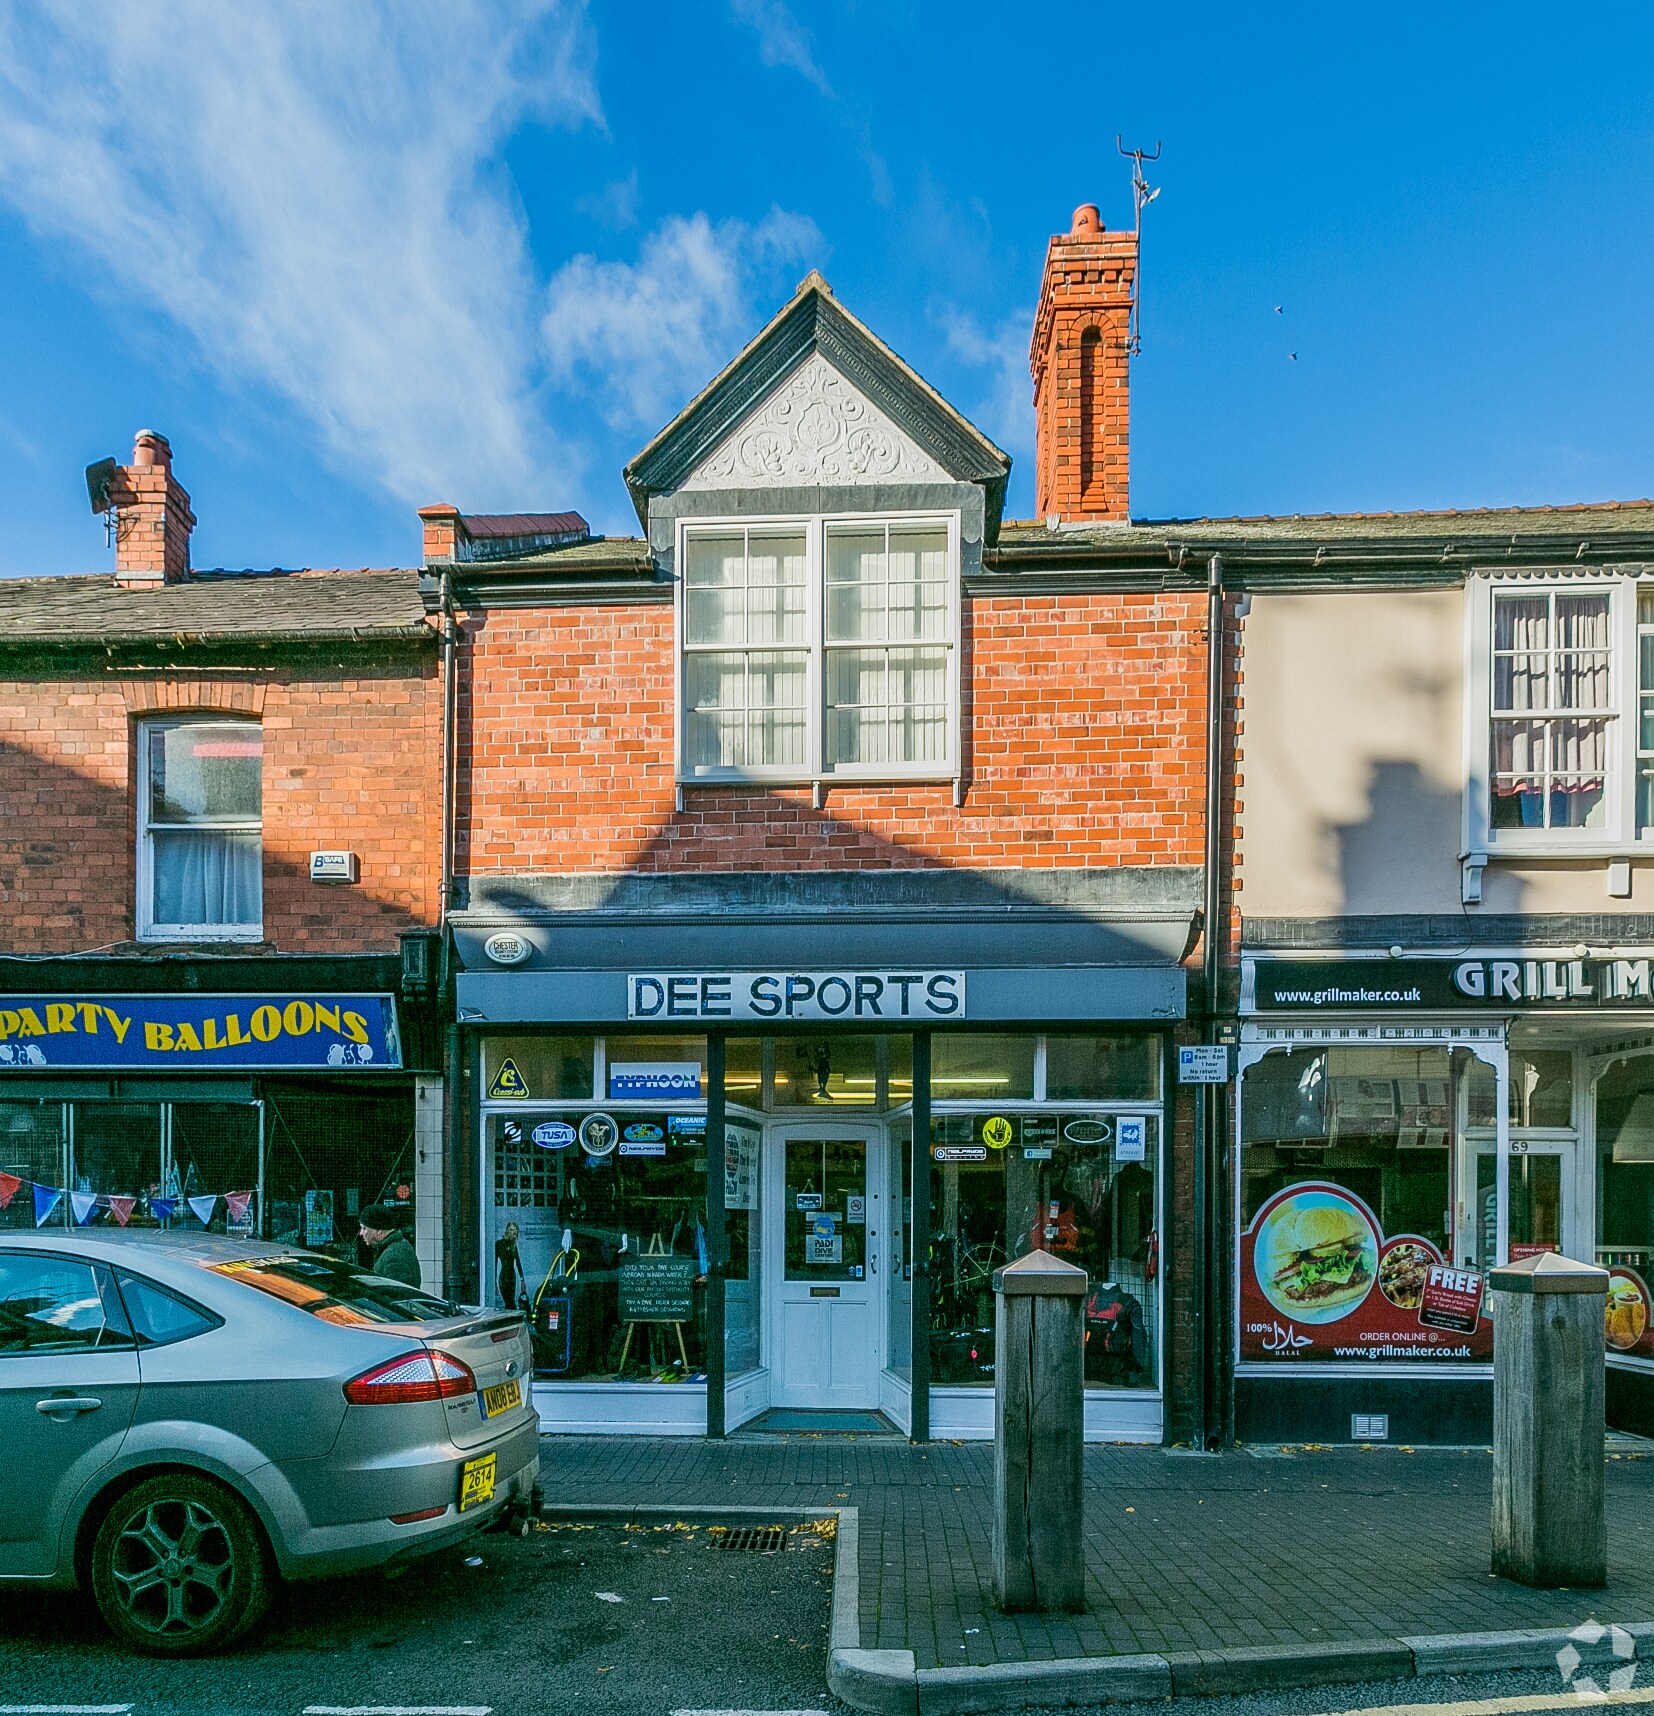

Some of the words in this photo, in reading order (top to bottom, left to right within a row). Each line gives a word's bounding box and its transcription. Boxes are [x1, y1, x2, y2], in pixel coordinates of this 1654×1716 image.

[493, 941, 519, 950] CHESTER
[1453, 961, 1593, 1001] GRILL
[1605, 960, 1654, 999] M
[634, 976, 732, 1017] DEE
[748, 974, 959, 1017] SPORTS
[1274, 987, 1421, 1004] www.grillmaker.co.uk
[0, 1002, 131, 1044] PARTY
[144, 1001, 369, 1051] BALLOONS
[615, 1074, 696, 1088] TYPHOON
[541, 1130, 568, 1140] TUSA
[1511, 1141, 1528, 1152] 69
[814, 1239, 834, 1248] PADI
[1429, 1267, 1479, 1295] FREE
[1246, 1323, 1273, 1333] 100%
[1262, 1320, 1314, 1350] حلال
[1359, 1332, 1390, 1341] ORDER
[1391, 1332, 1427, 1341] ONLINE
[1334, 1344, 1471, 1359] www.grillmaker.co.uk
[468, 1466, 492, 1490] 2614
